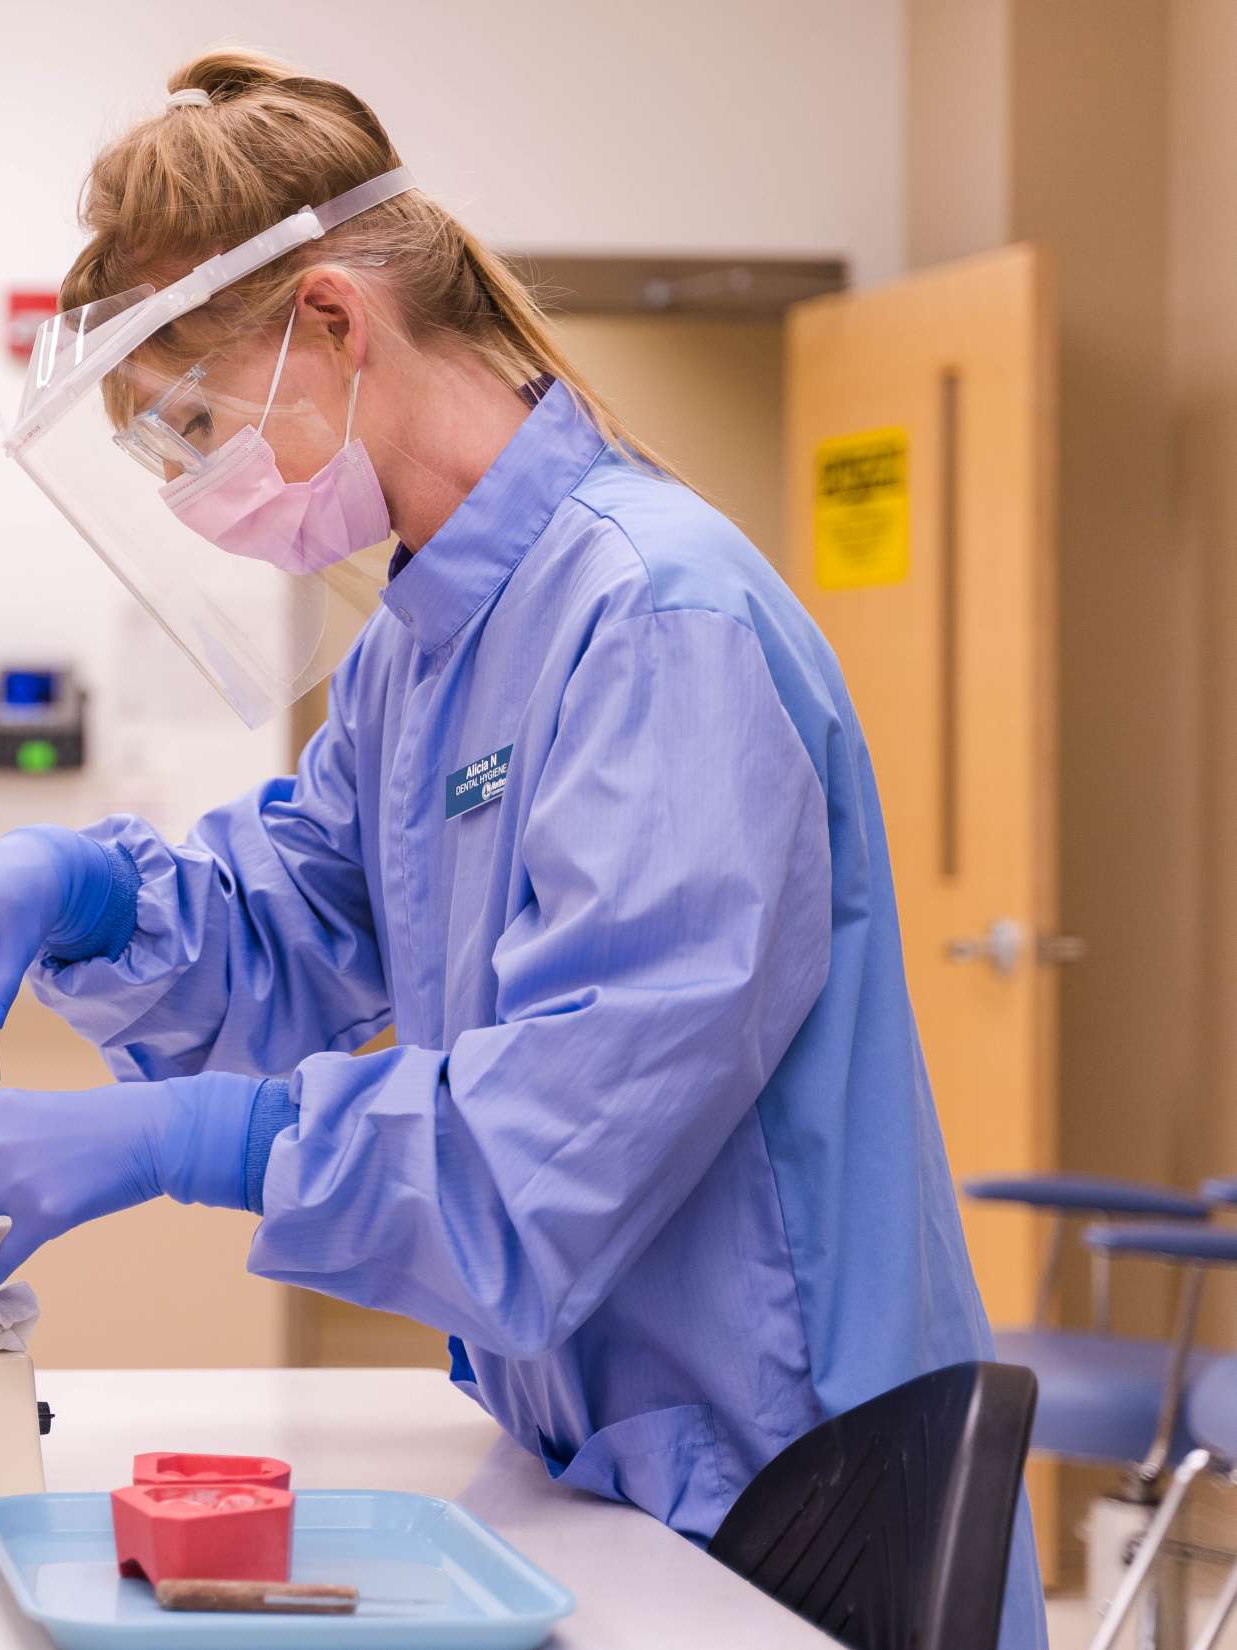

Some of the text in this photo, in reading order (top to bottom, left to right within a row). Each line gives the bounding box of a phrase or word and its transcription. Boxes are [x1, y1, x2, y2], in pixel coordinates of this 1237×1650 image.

[455, 777, 479, 796] DENTAL
[480, 763, 507, 785] HYGIENE
[466, 753, 497, 780] Alicia N
